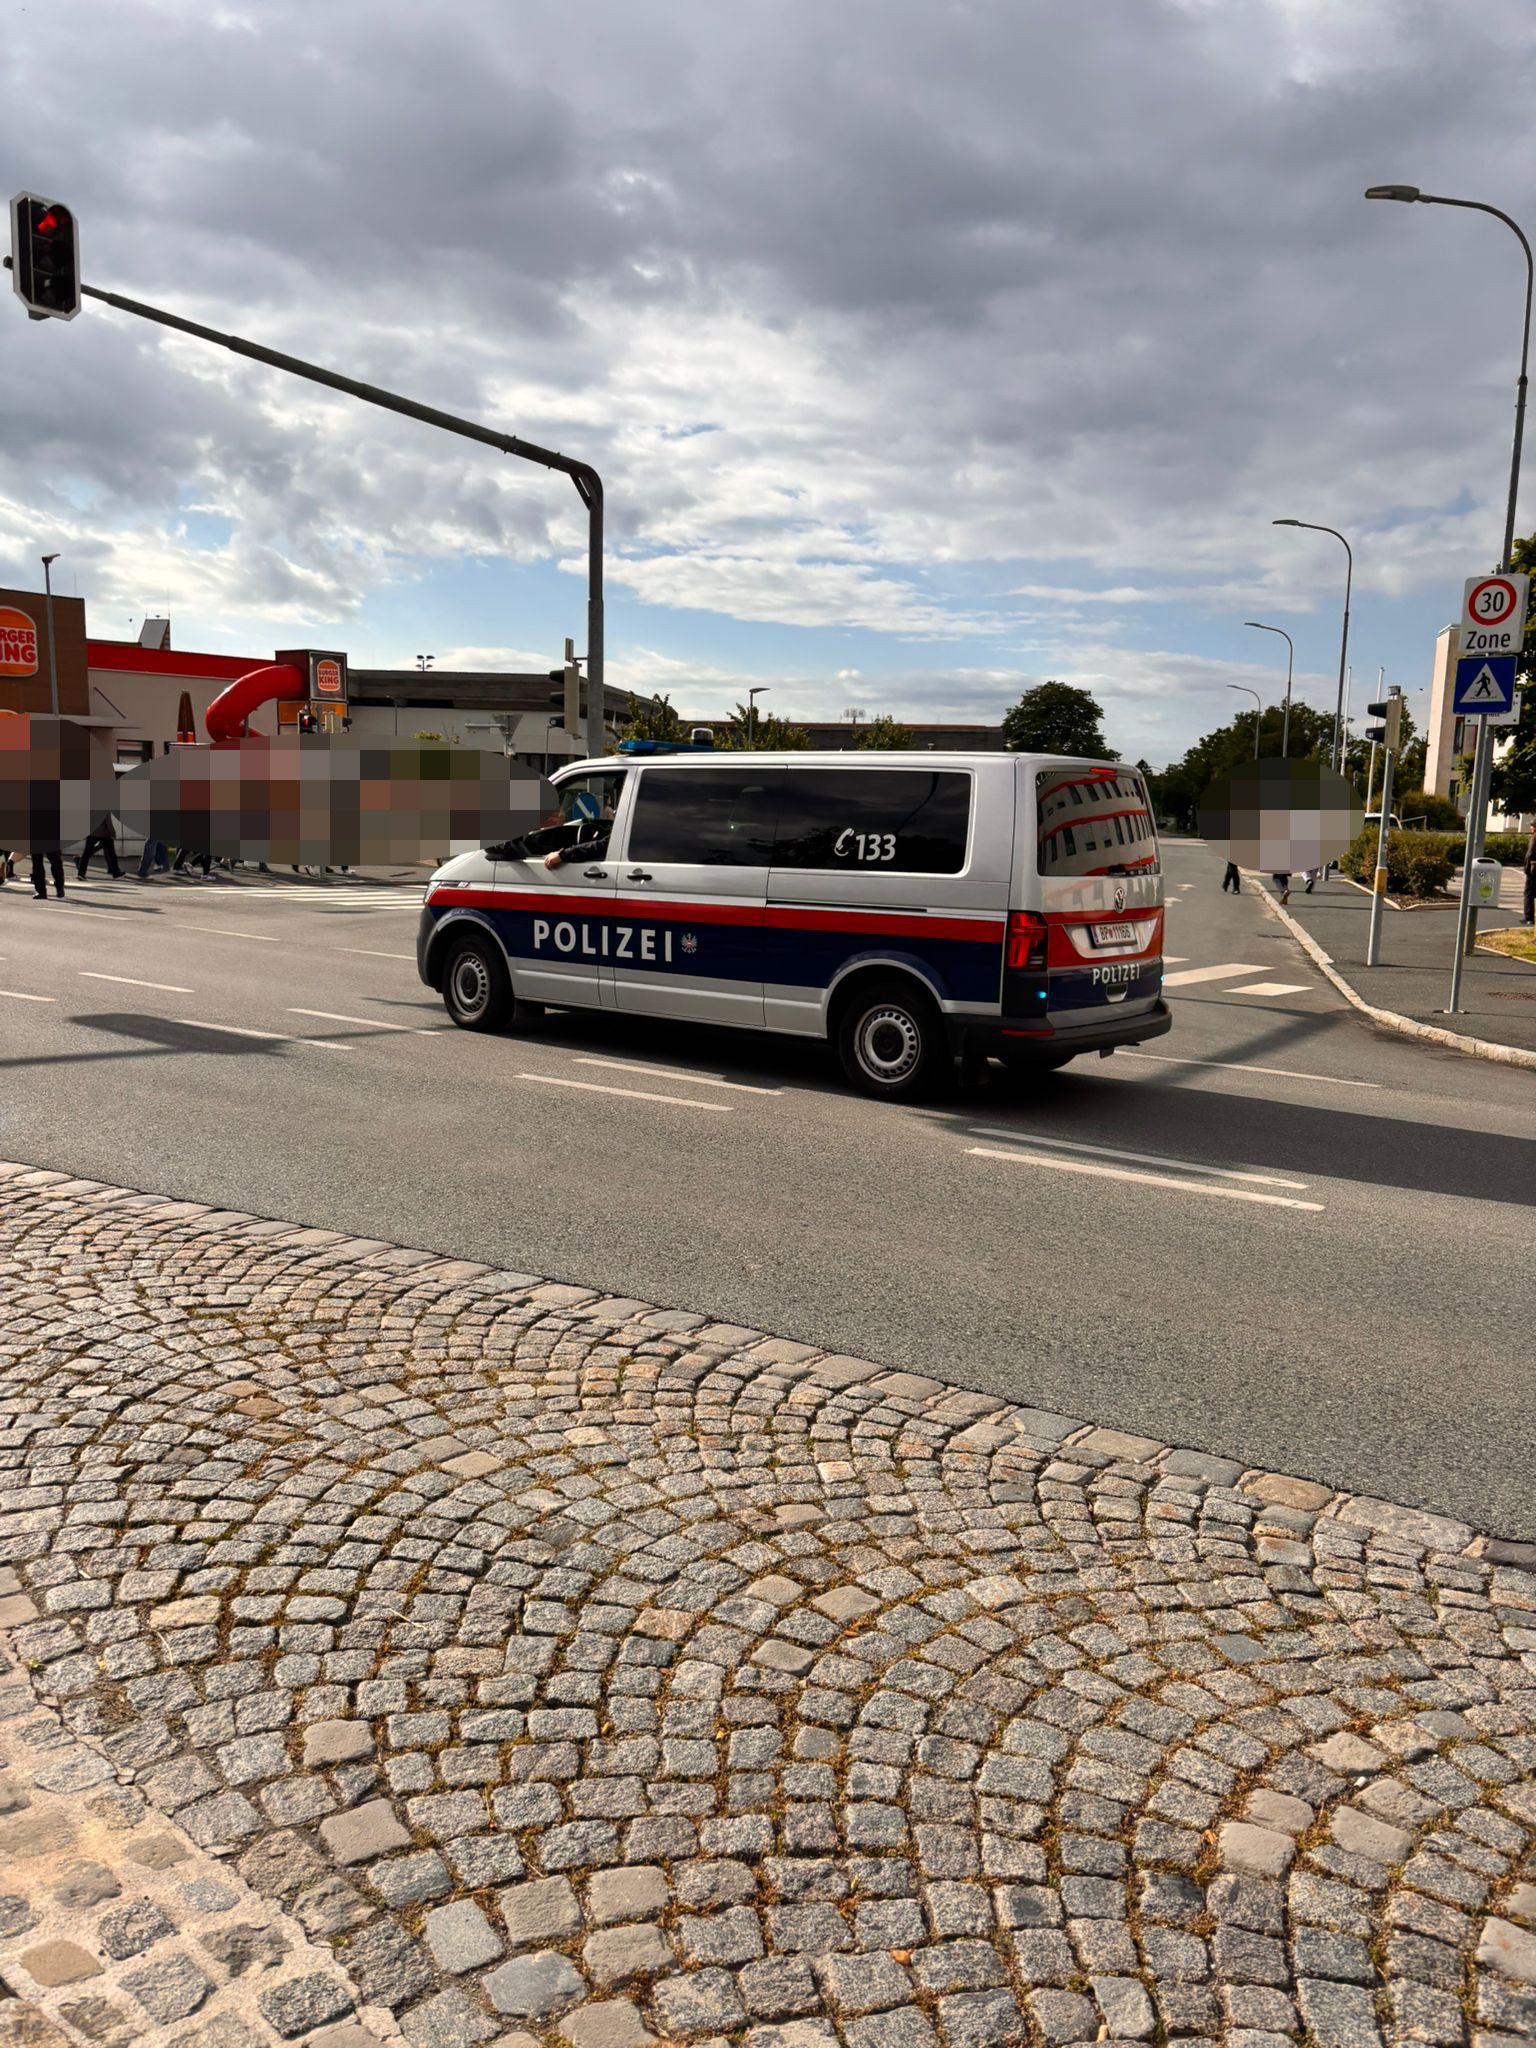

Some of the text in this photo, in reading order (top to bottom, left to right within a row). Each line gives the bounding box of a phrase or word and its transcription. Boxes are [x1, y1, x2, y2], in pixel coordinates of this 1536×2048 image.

[1481, 591, 1504, 613] 30
[1466, 631, 1511, 649] Zone
[319, 675, 339, 685] KING
[856, 833, 896, 861] 133
[533, 919, 673, 963] POLIZEI
[1092, 963, 1140, 985] POLIZEI
